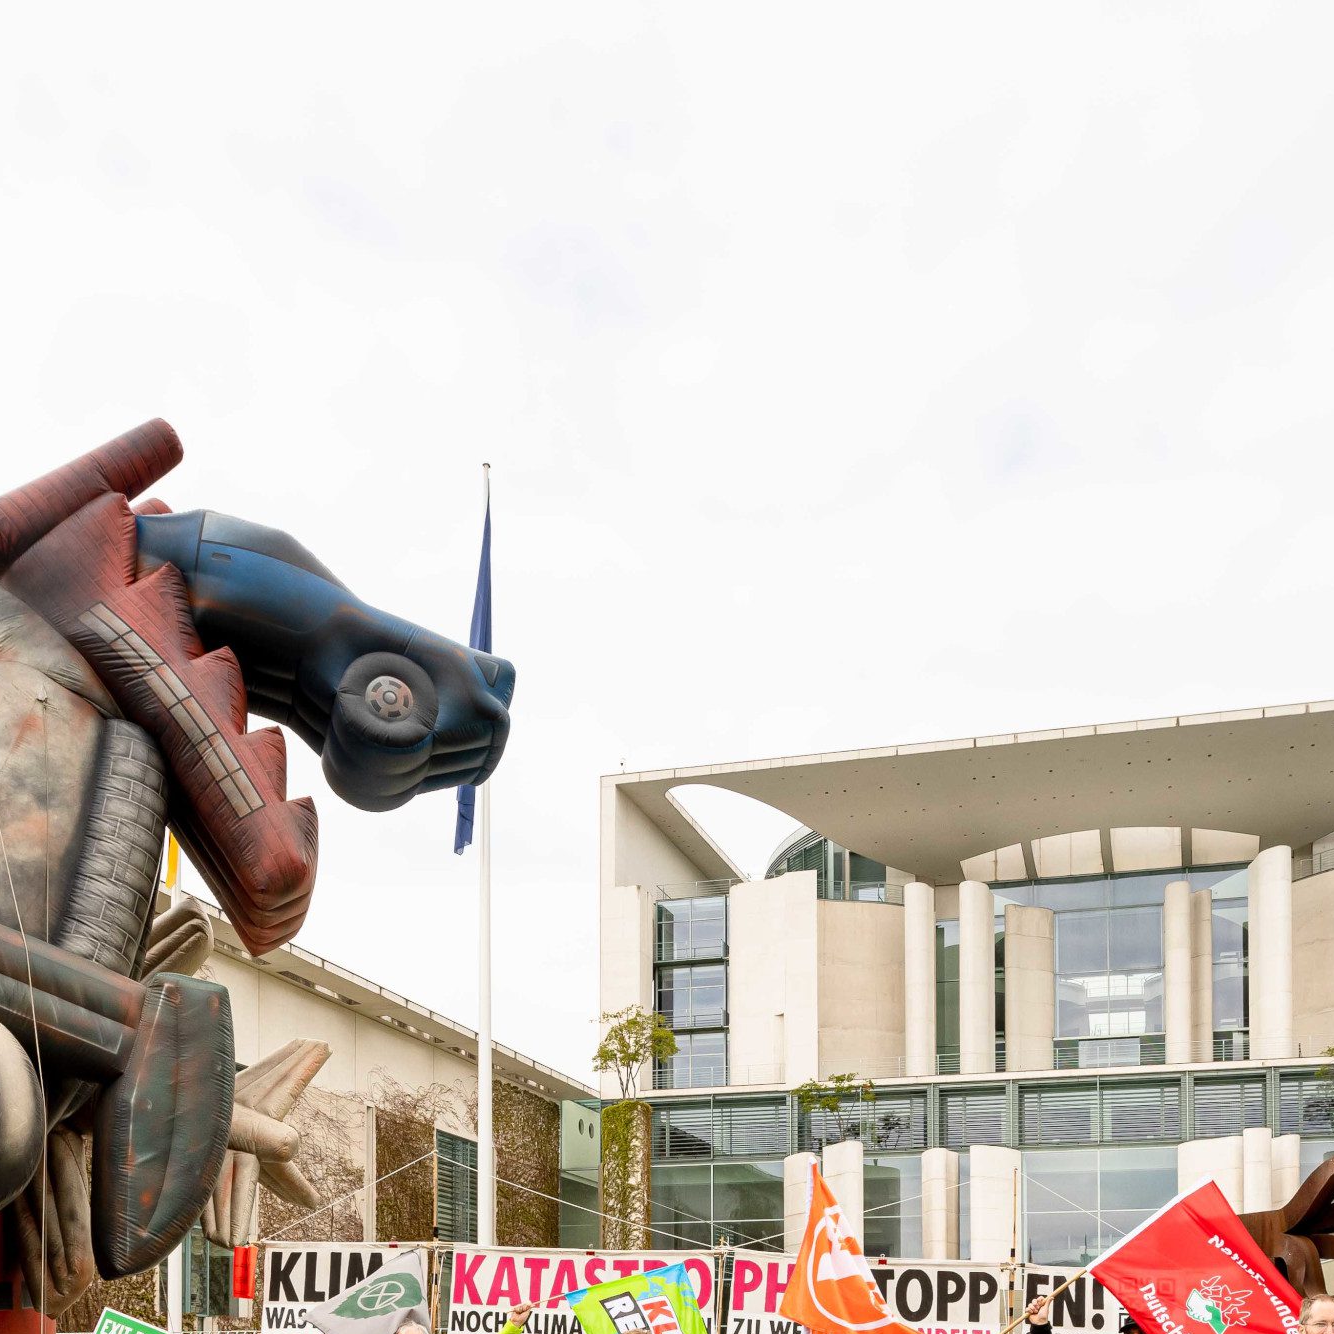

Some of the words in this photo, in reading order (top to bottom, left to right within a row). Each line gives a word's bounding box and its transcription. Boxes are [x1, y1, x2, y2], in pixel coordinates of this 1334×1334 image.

[269, 1251, 384, 1302] KLIM
[733, 1259, 795, 1313] PH
[870, 1269, 999, 1322] TOPP
[451, 1310, 508, 1333] NOCH
